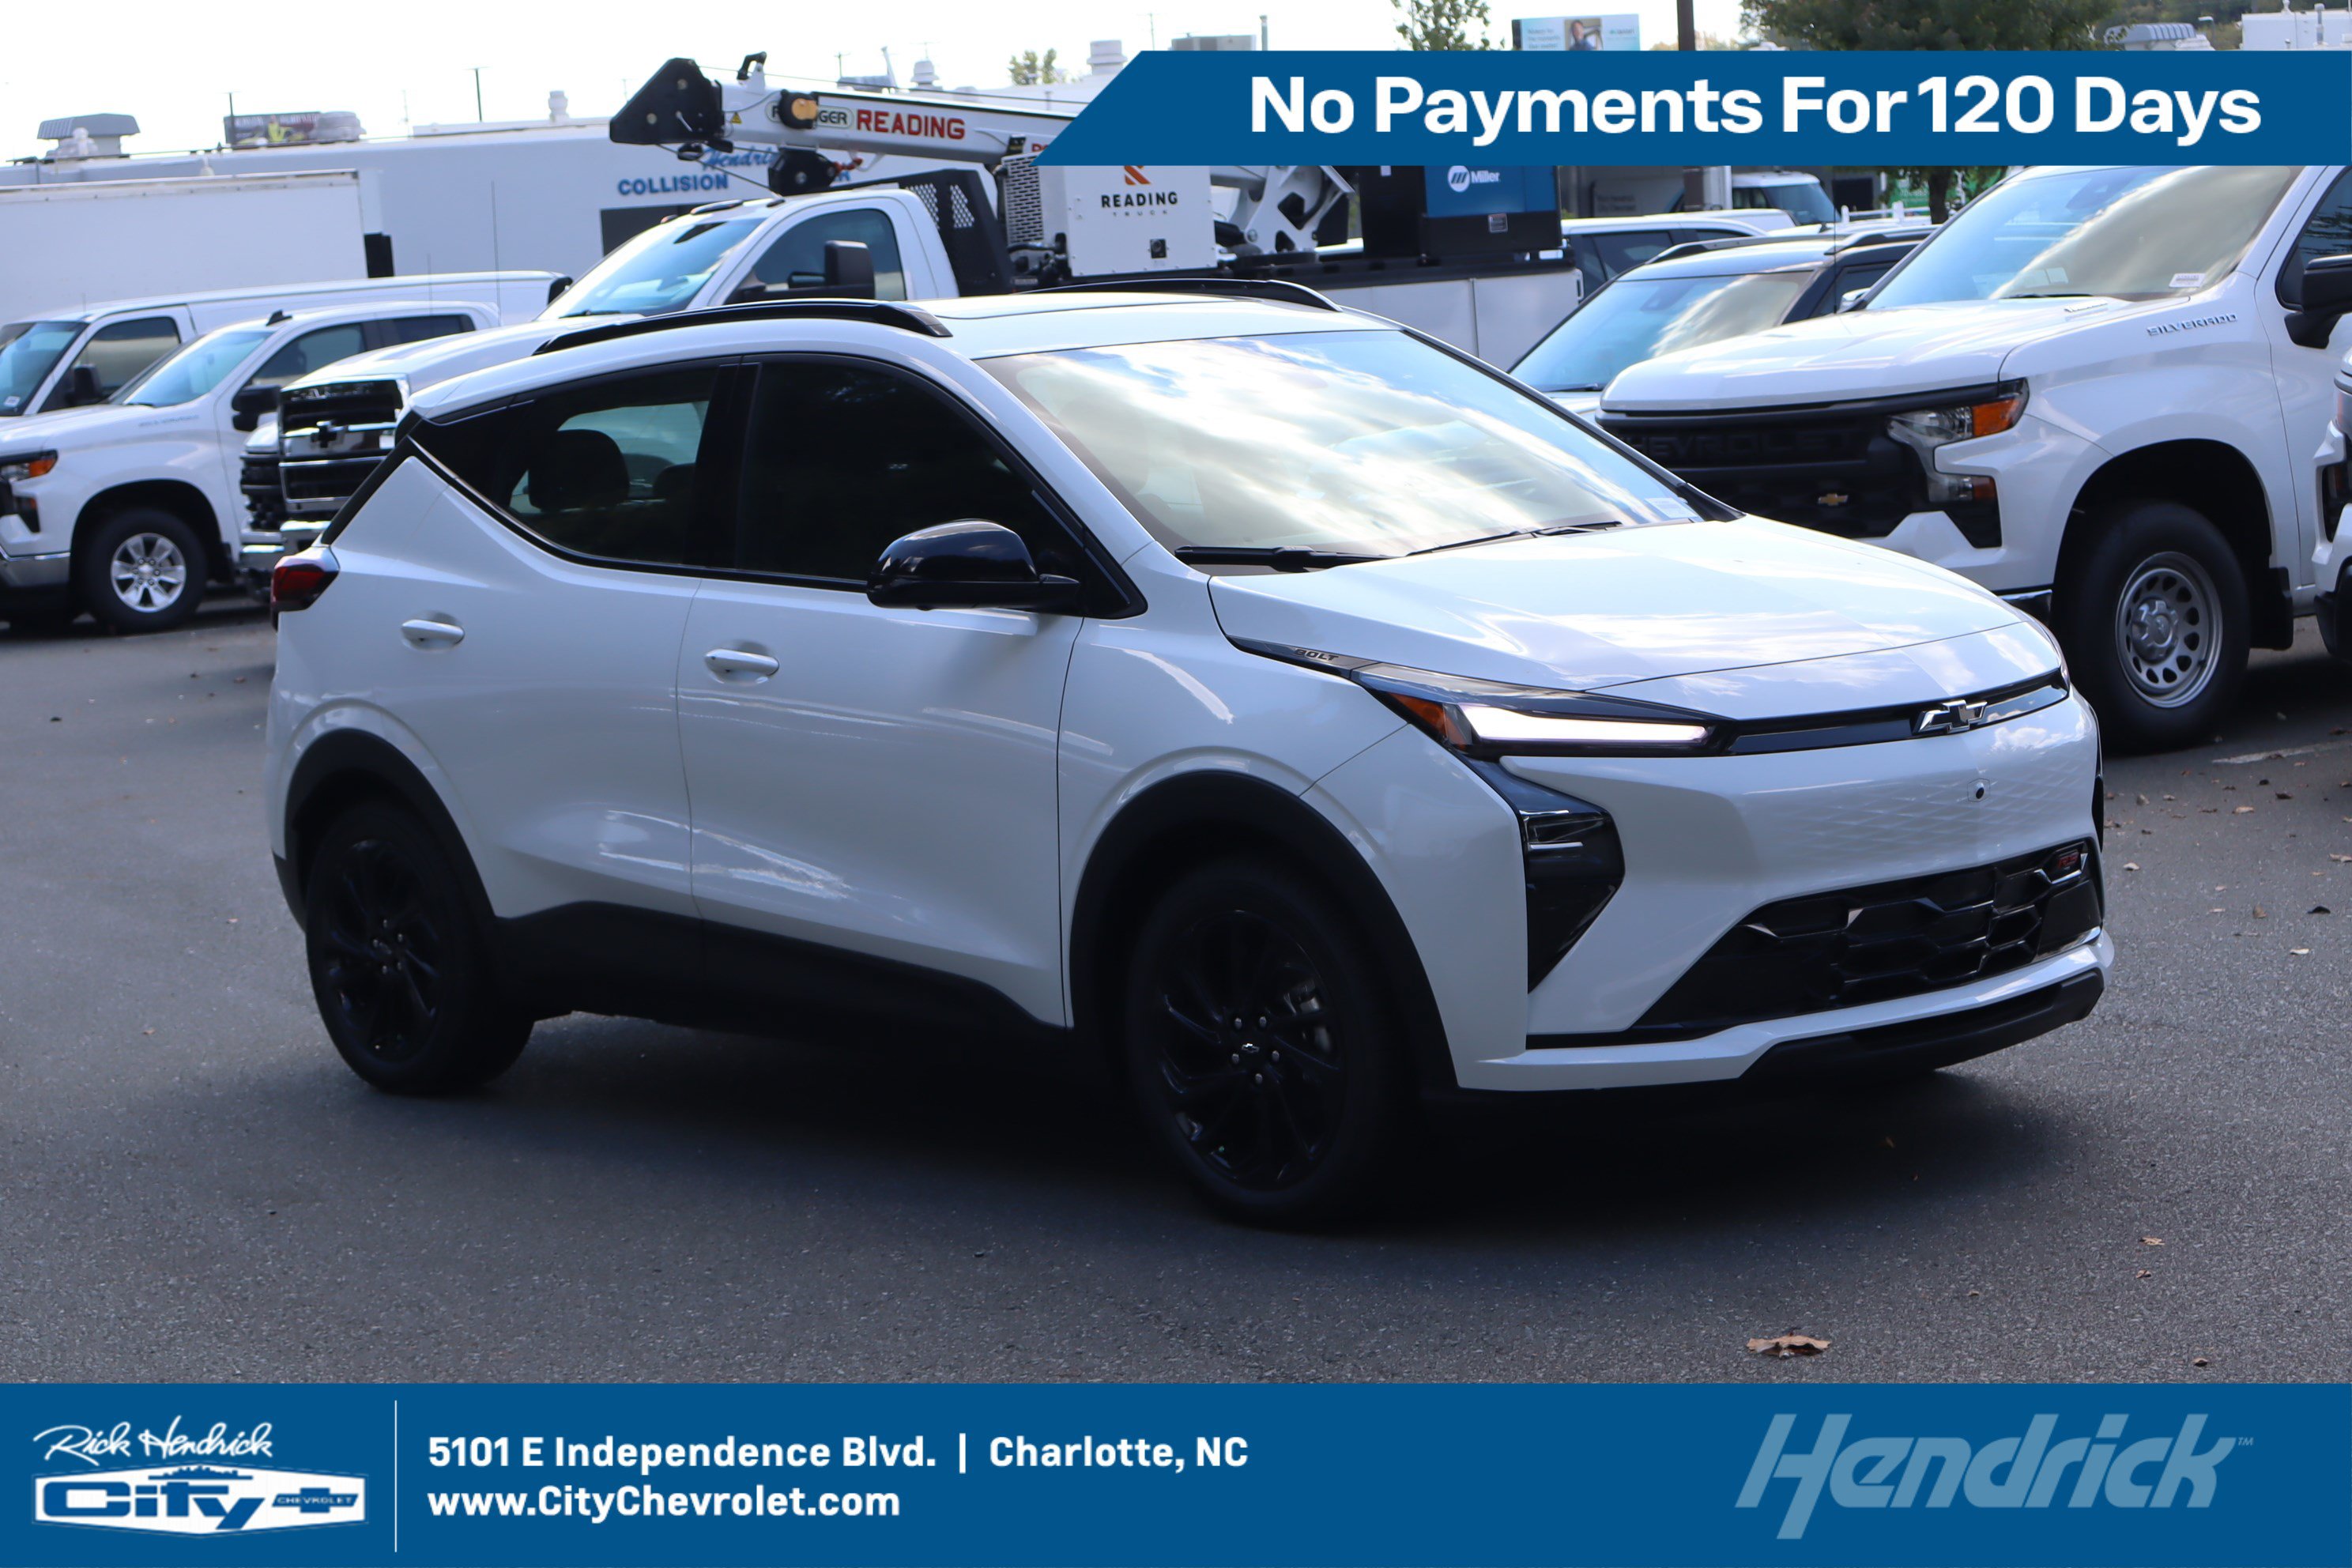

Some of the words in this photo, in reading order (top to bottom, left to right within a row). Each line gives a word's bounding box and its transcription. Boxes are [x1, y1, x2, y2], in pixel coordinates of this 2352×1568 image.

[857, 109, 965, 140] READING
[617, 174, 729, 196] COLLISION
[1471, 170, 1501, 183] Miller
[1101, 191, 1178, 208] READING
[2147, 314, 2237, 337] SILVERADO
[1295, 648, 1339, 661] BOLT
